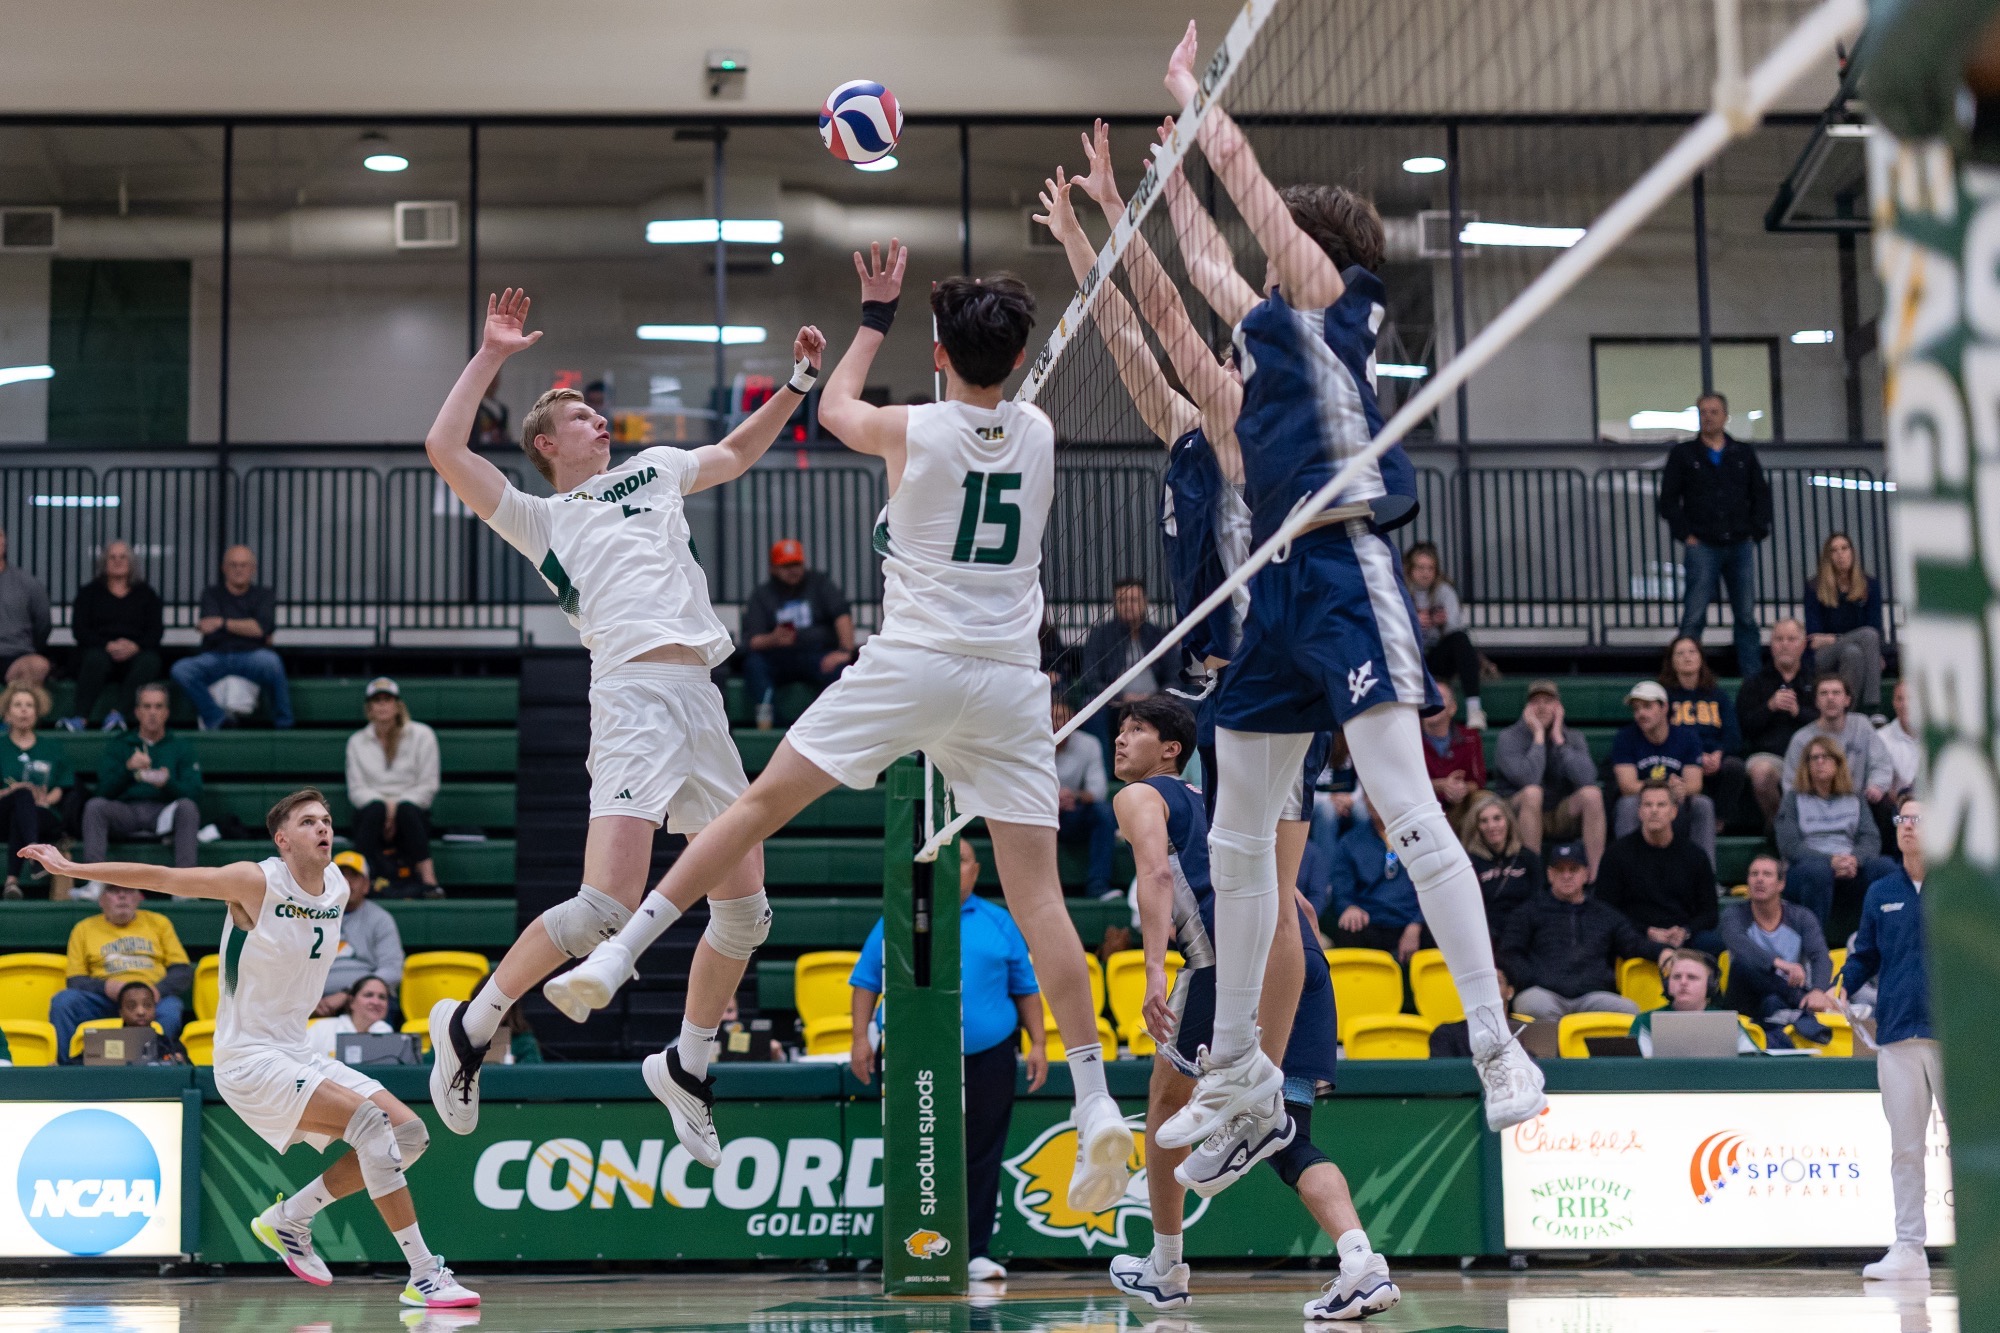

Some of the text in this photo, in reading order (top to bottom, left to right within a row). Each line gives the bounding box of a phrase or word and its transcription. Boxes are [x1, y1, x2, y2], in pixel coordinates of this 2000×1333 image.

[951, 470, 1022, 565] 15
[309, 926, 324, 959] 2
[914, 1070, 938, 1215] sports imports
[1746, 1145, 1860, 1159] NATIONAL
[1748, 1158, 1860, 1183] SPORTS
[29, 1179, 158, 1218] NCAA
[1530, 1176, 1634, 1202] NEWPORT
[1748, 1185, 1860, 1197] APPAREL
[1557, 1196, 1609, 1218] RIB
[746, 1213, 875, 1237] GOLDEN
[1531, 1213, 1635, 1241] COMPANY
